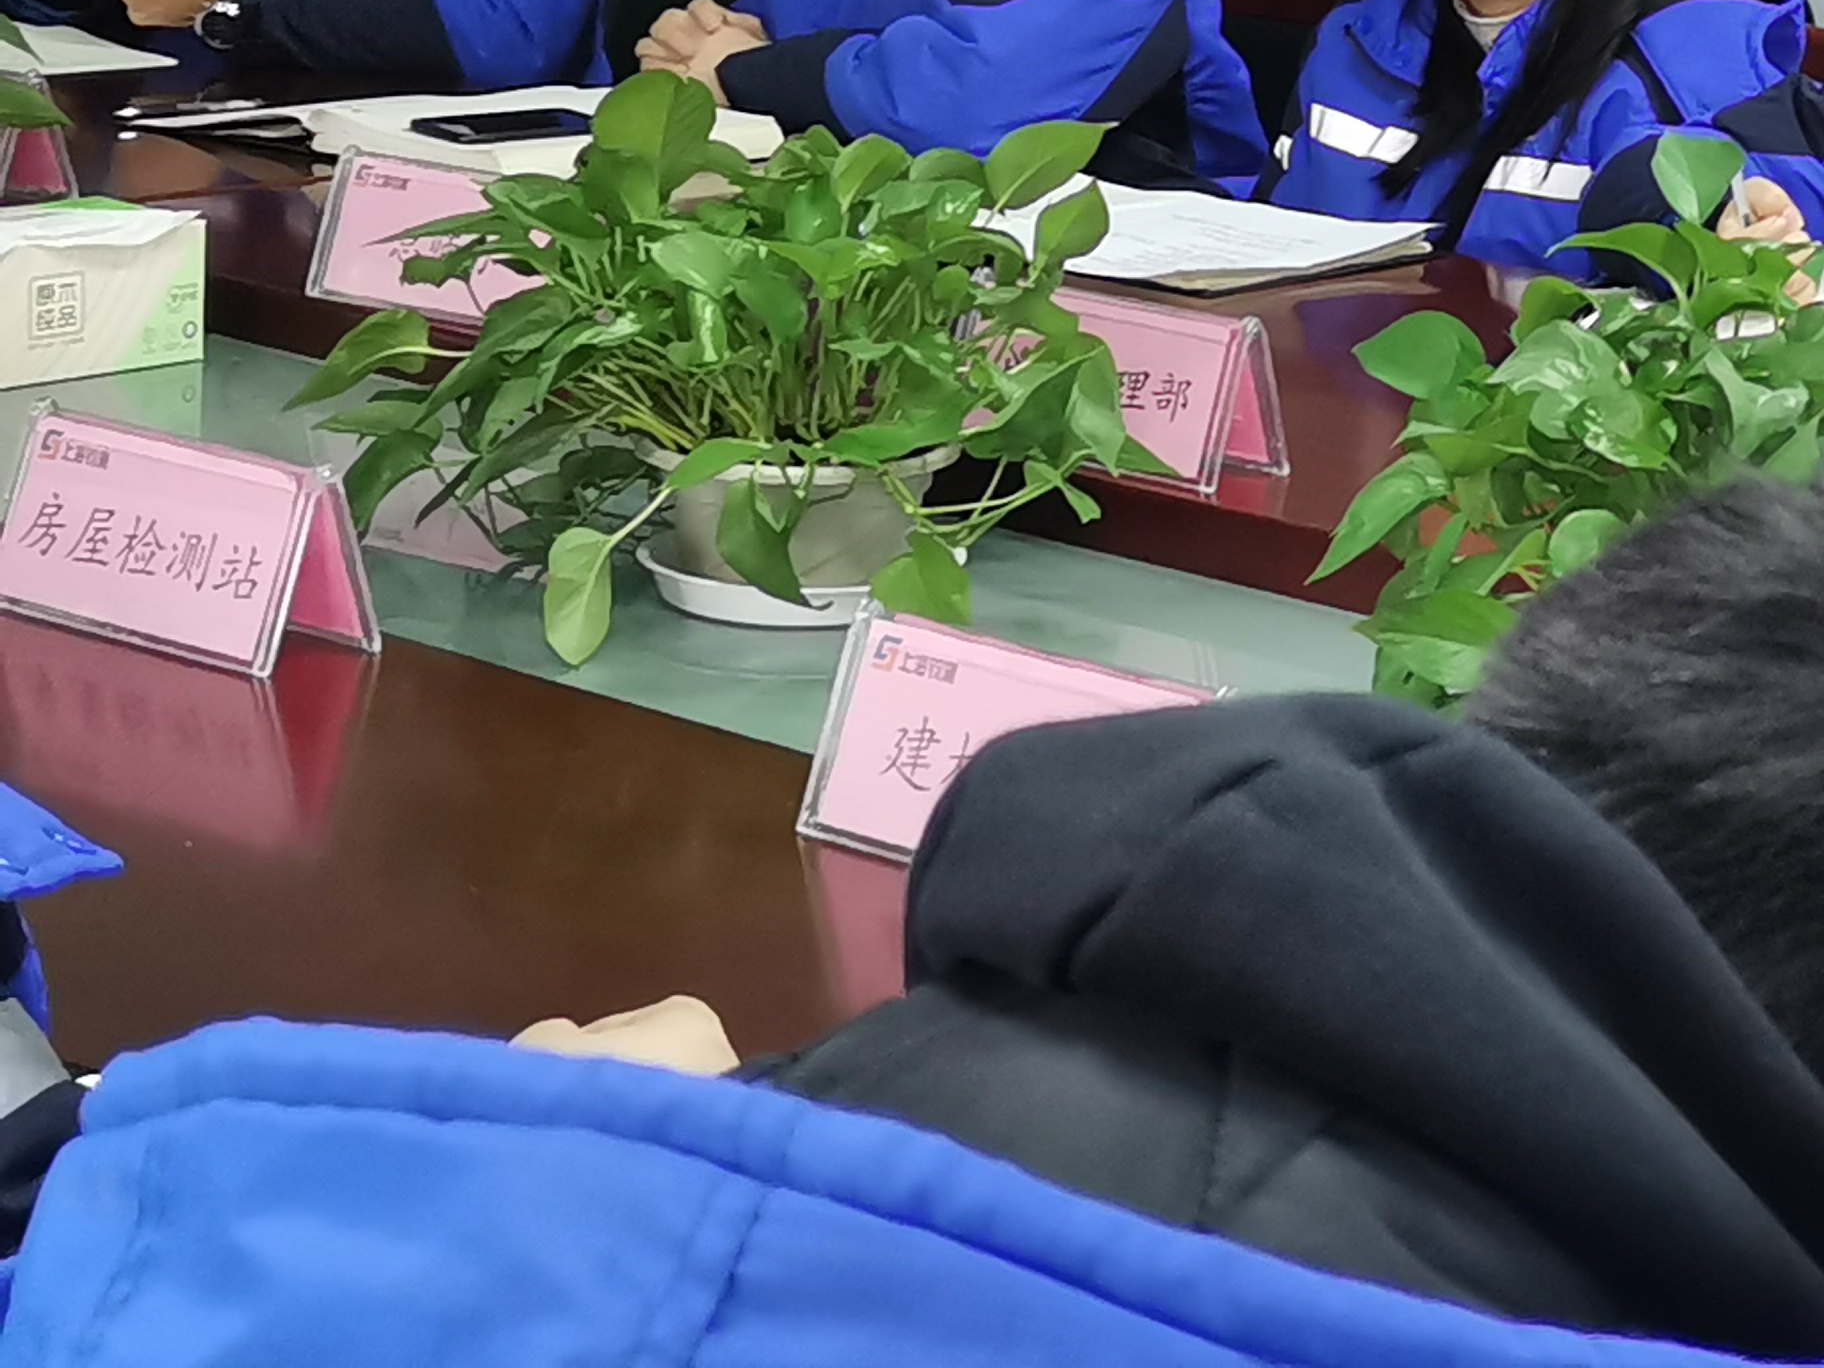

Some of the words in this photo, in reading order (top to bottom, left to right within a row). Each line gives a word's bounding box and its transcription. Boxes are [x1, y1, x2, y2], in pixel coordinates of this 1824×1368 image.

[18, 492, 263, 600] 房屋检测站
